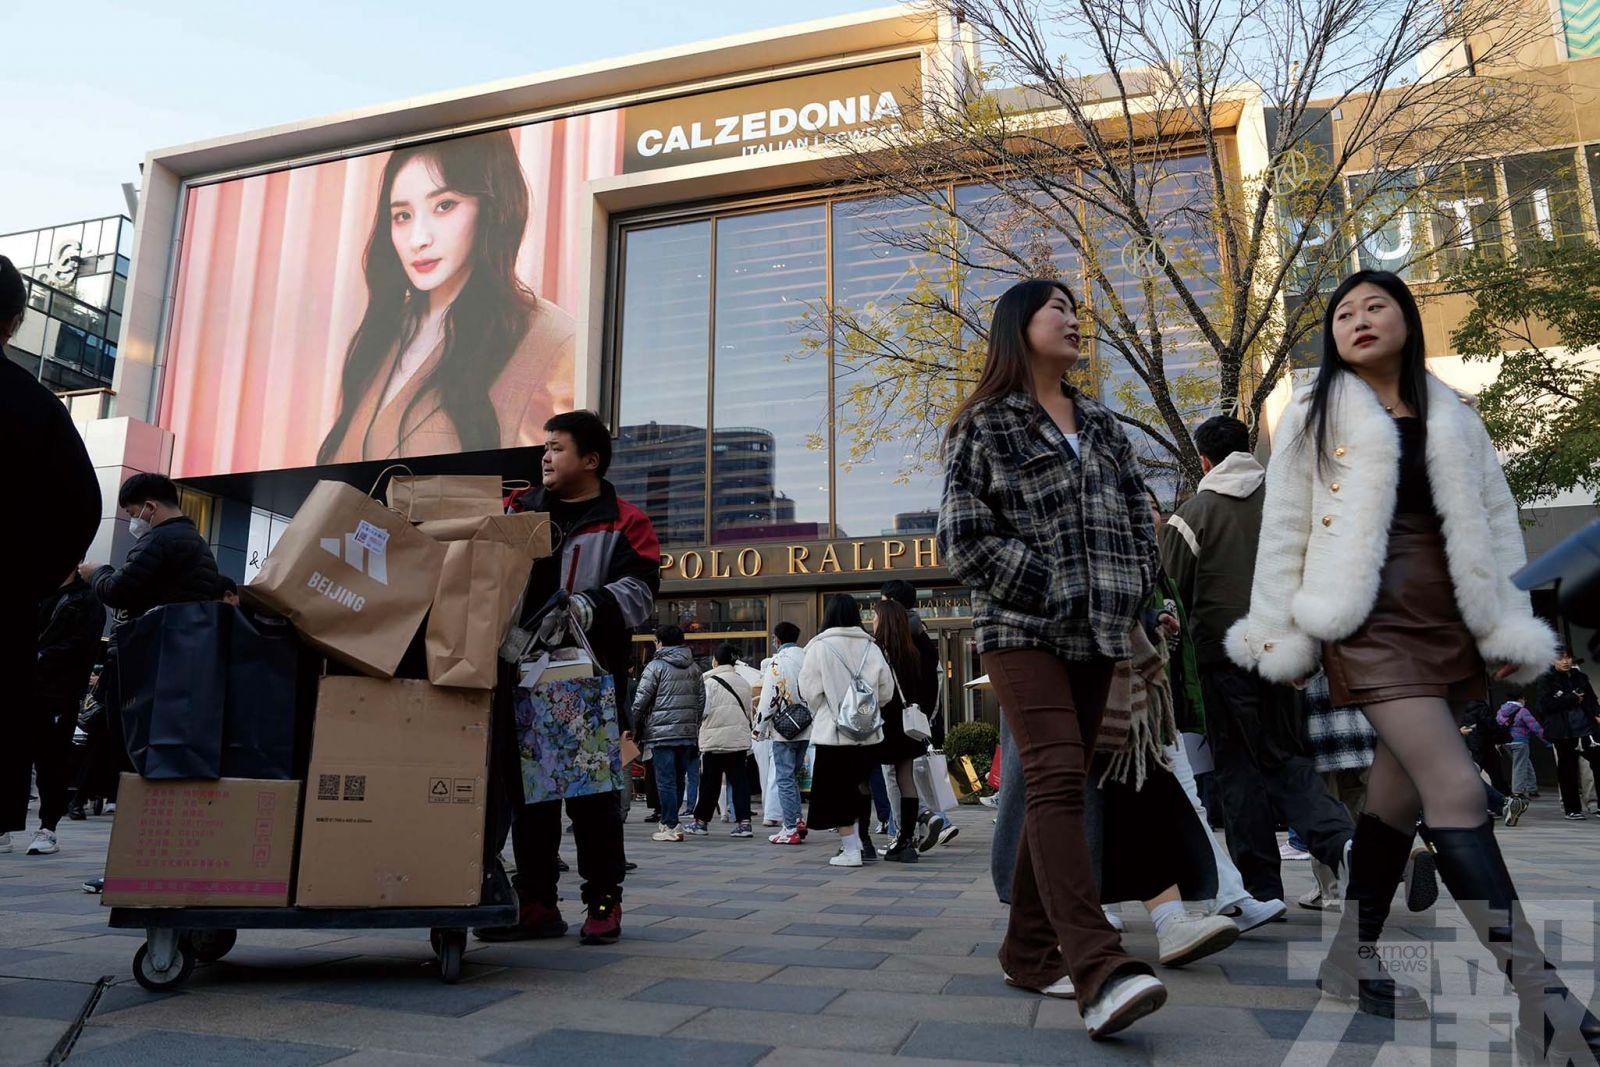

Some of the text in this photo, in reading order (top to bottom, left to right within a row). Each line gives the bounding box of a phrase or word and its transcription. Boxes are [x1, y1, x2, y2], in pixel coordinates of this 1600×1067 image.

[637, 91, 901, 156] CALZEDONIA
[741, 137, 808, 157] ITALIAN
[659, 537, 940, 580] POLO RALPH
[306, 571, 366, 613] BEIJING
[918, 597, 970, 609] LAUREN
